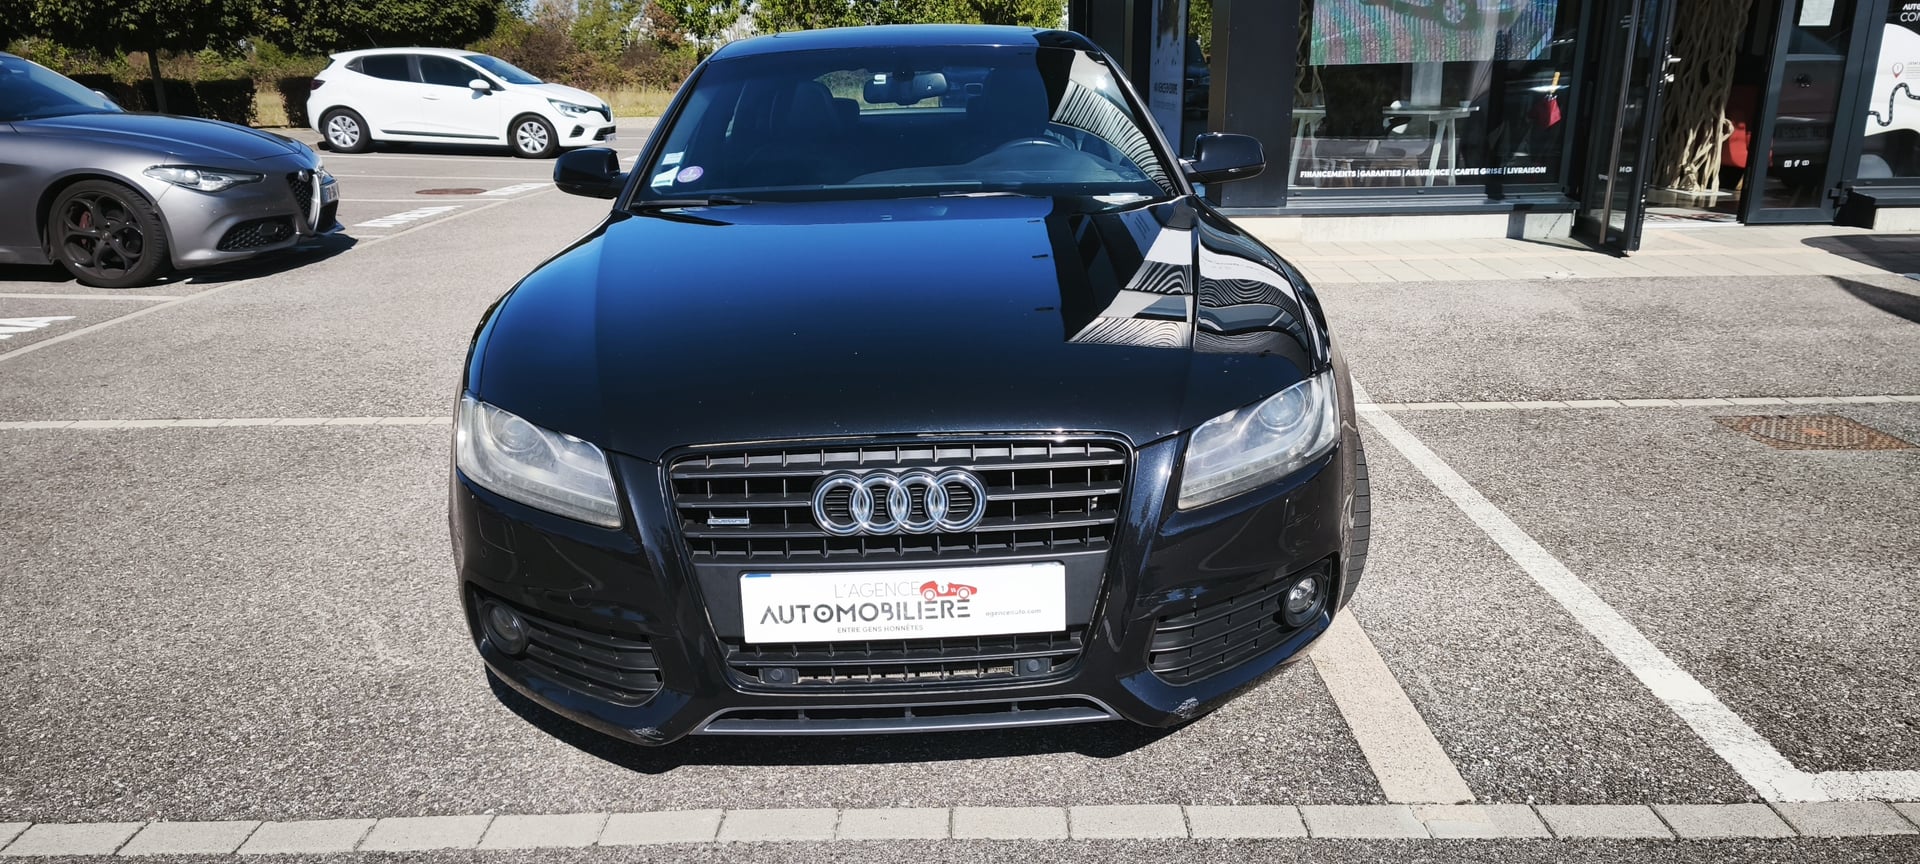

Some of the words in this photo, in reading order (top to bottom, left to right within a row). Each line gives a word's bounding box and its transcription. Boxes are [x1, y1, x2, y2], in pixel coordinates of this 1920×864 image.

[1300, 170, 1357, 178] FINANCEMENTS
[1360, 169, 1401, 177] GARANTIES
[1405, 168, 1450, 177] ASSURANCE
[1454, 167, 1479, 176] CARTE
[1480, 167, 1503, 176] GRISE
[1507, 166, 1547, 175] LIVRAISON
[834, 581, 921, 599] L'AGENCE
[837, 626, 861, 634] ENTRE
